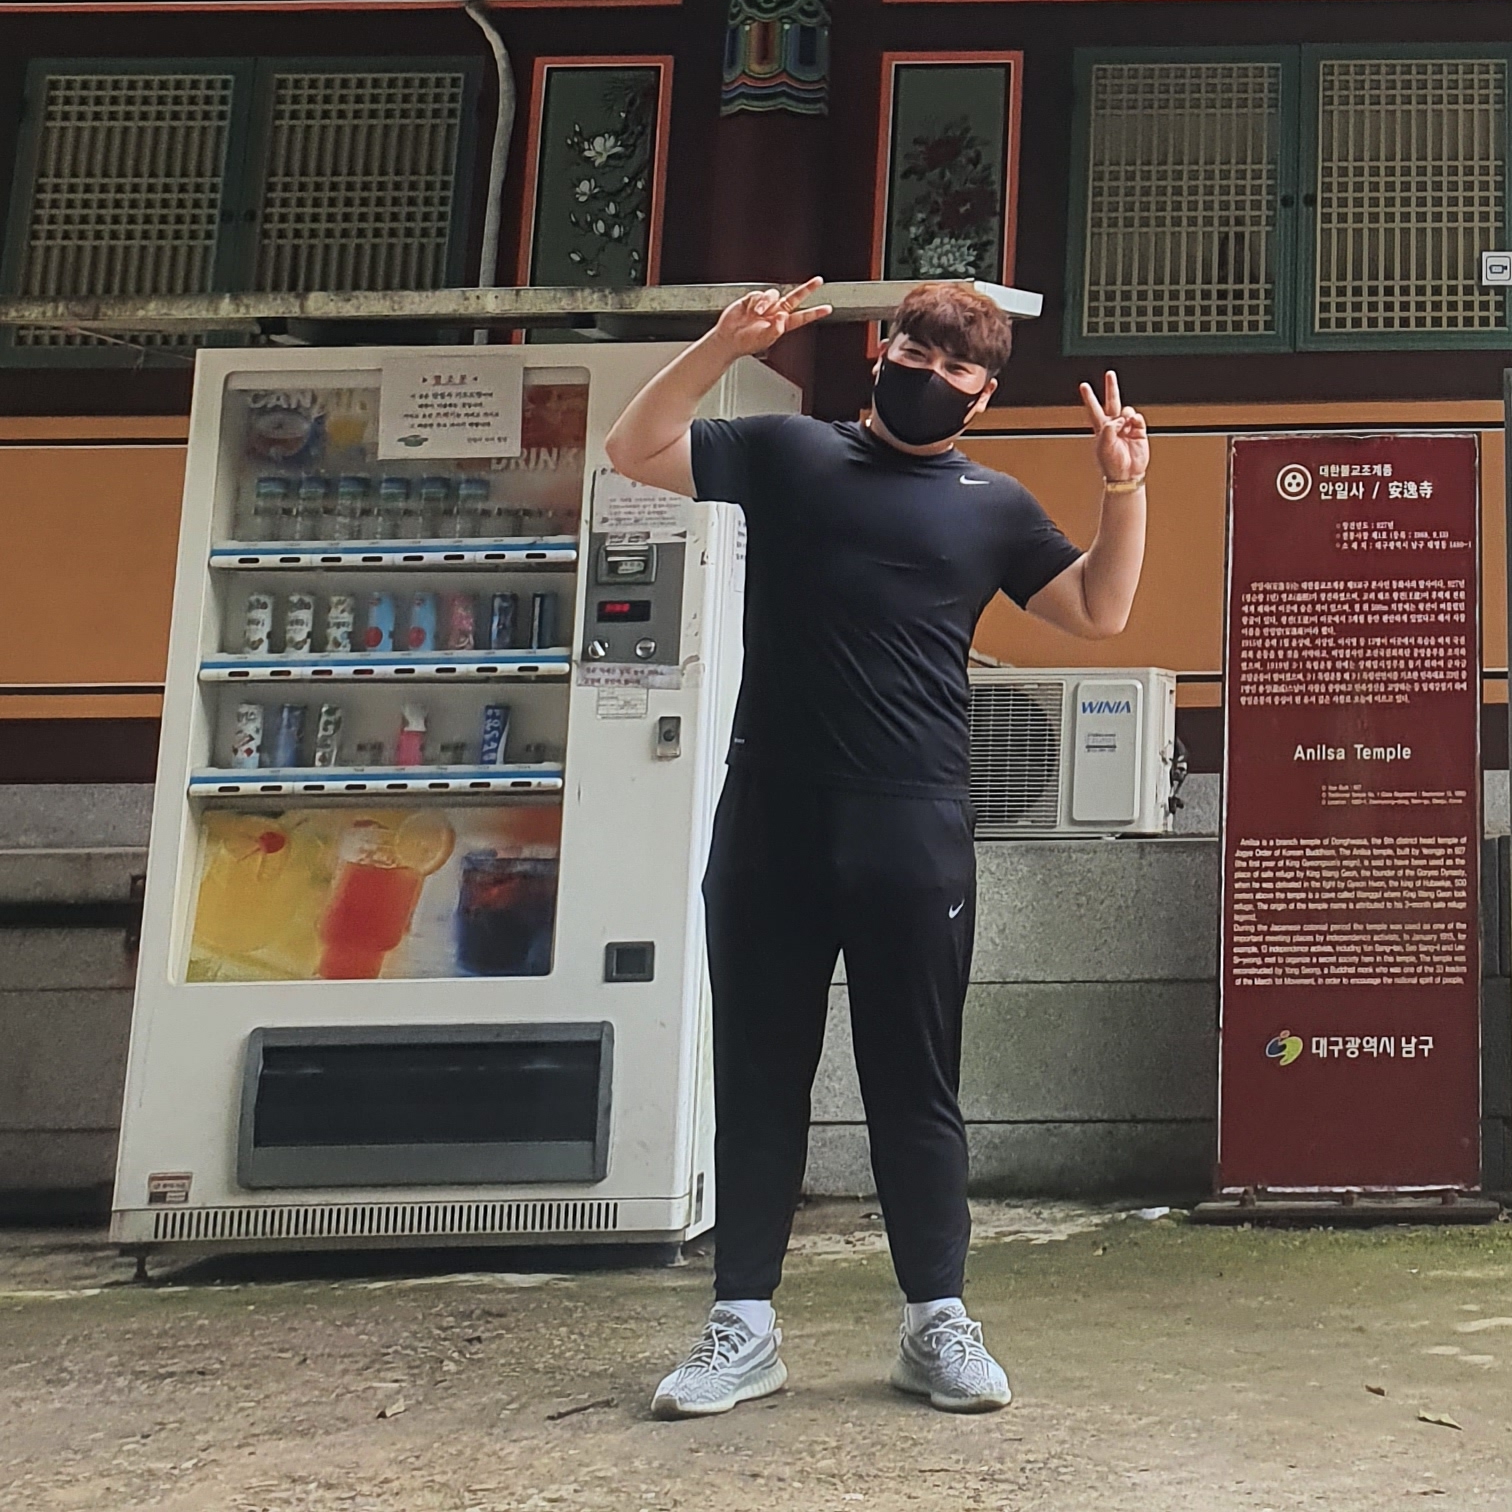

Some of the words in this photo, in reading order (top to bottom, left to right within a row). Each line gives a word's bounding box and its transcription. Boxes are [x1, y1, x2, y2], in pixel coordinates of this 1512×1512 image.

[1319, 482, 1364, 500] 안일사
[1082, 701, 1131, 714] WINIA
[1293, 744, 1346, 760] Anilsa
[1353, 743, 1412, 763] Temple
[1311, 1036, 1395, 1058] 대구광역시
[1401, 1036, 1434, 1058] 남구
